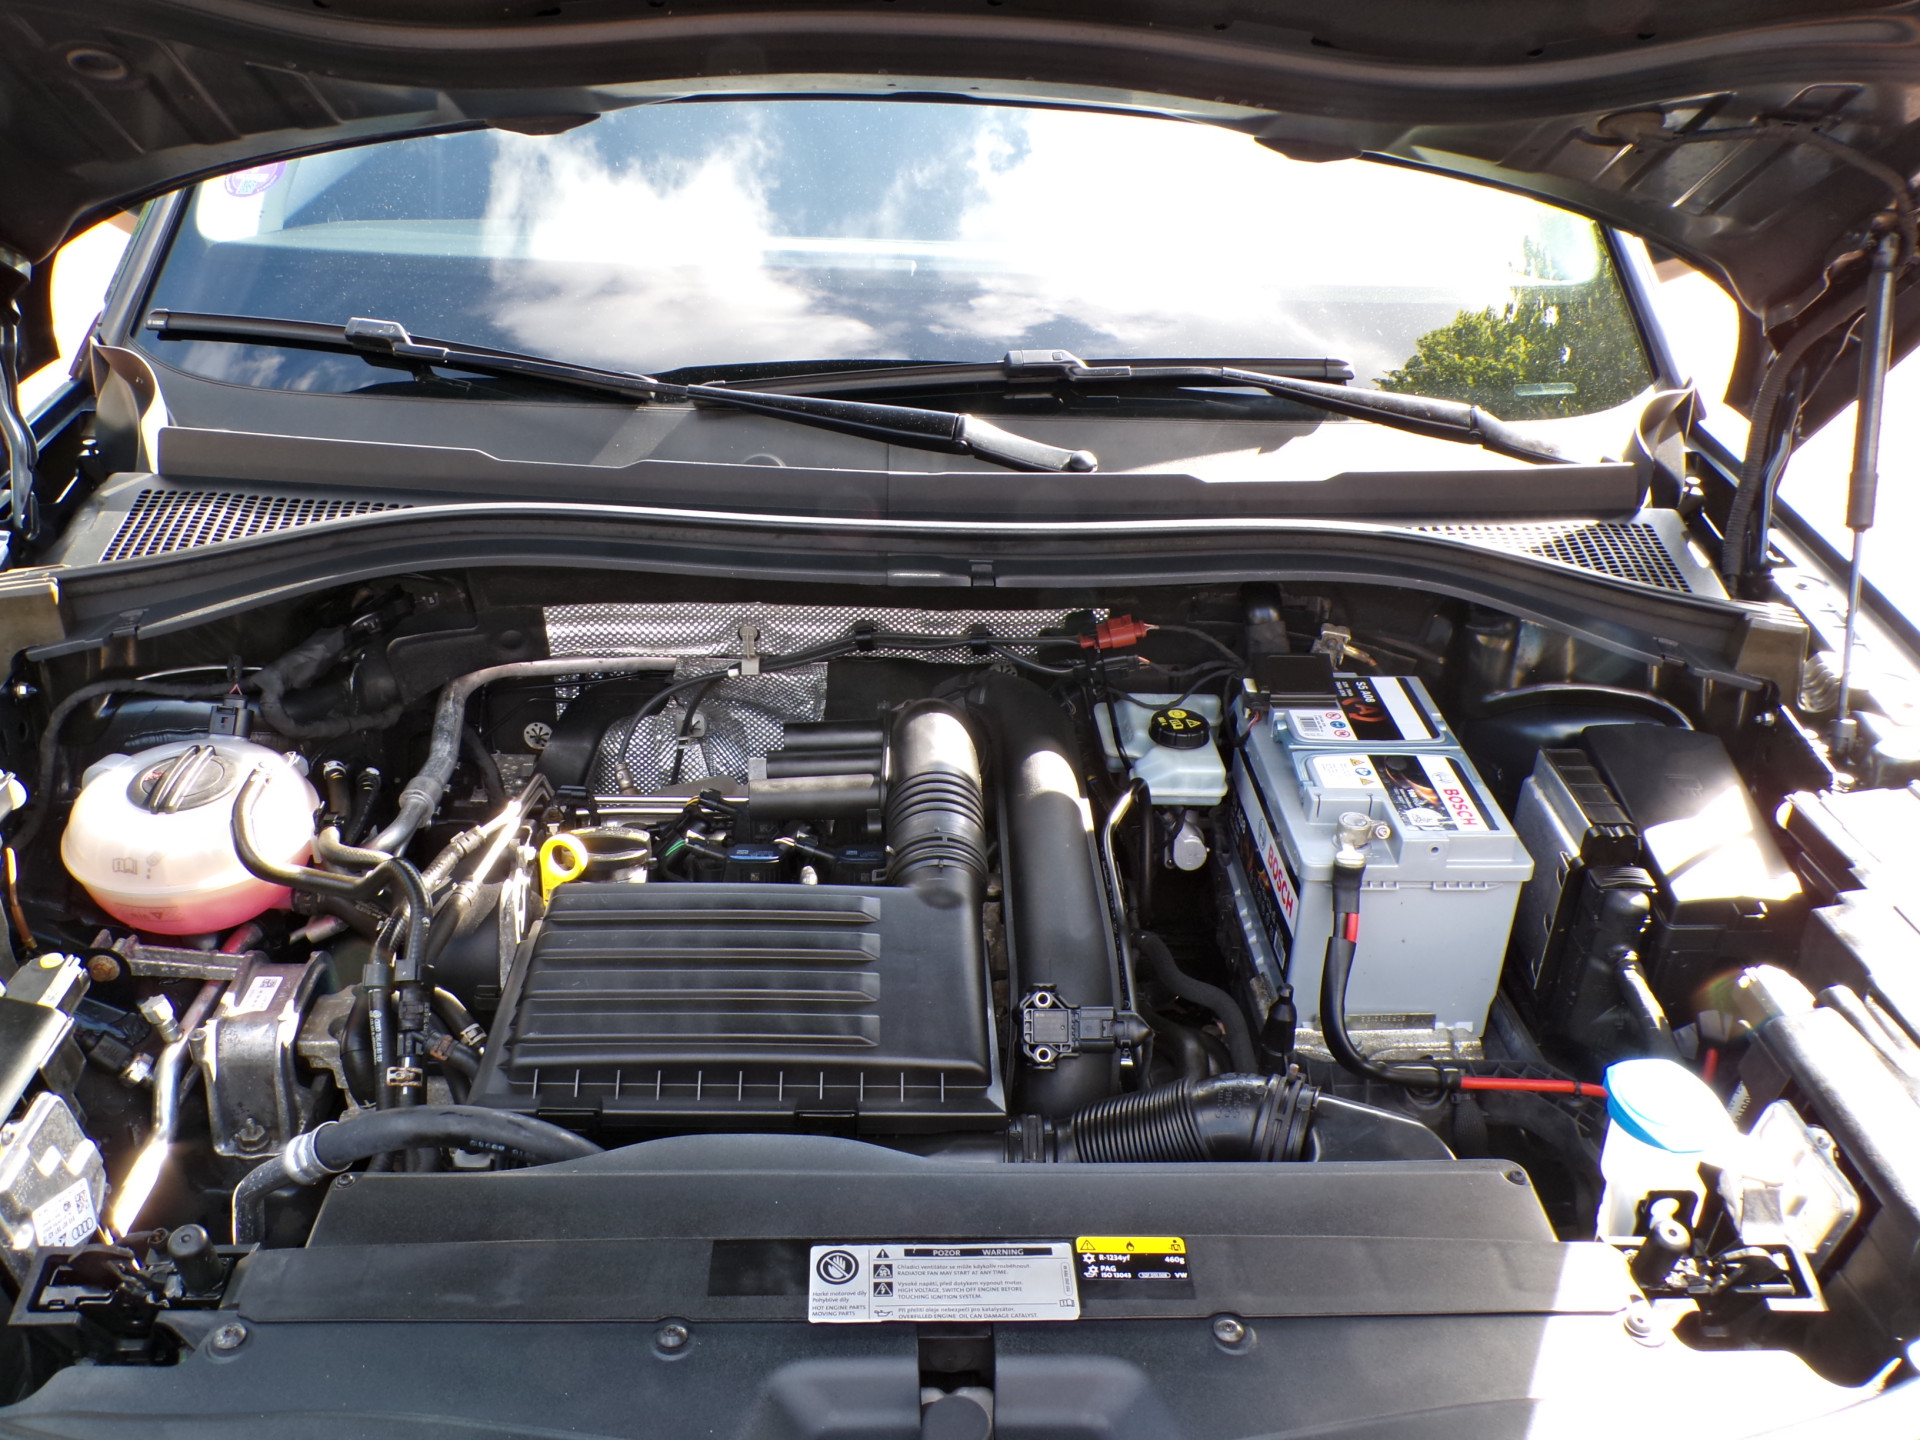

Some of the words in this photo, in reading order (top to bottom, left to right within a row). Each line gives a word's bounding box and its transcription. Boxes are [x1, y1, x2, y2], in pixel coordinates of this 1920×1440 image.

[1356, 682, 1368, 690] S5
[1444, 788, 1478, 826] BOSCH
[1267, 844, 1294, 918] BOSCH
[1098, 1254, 1130, 1262] R-1234yf
[1164, 1256, 1185, 1264] 460g
